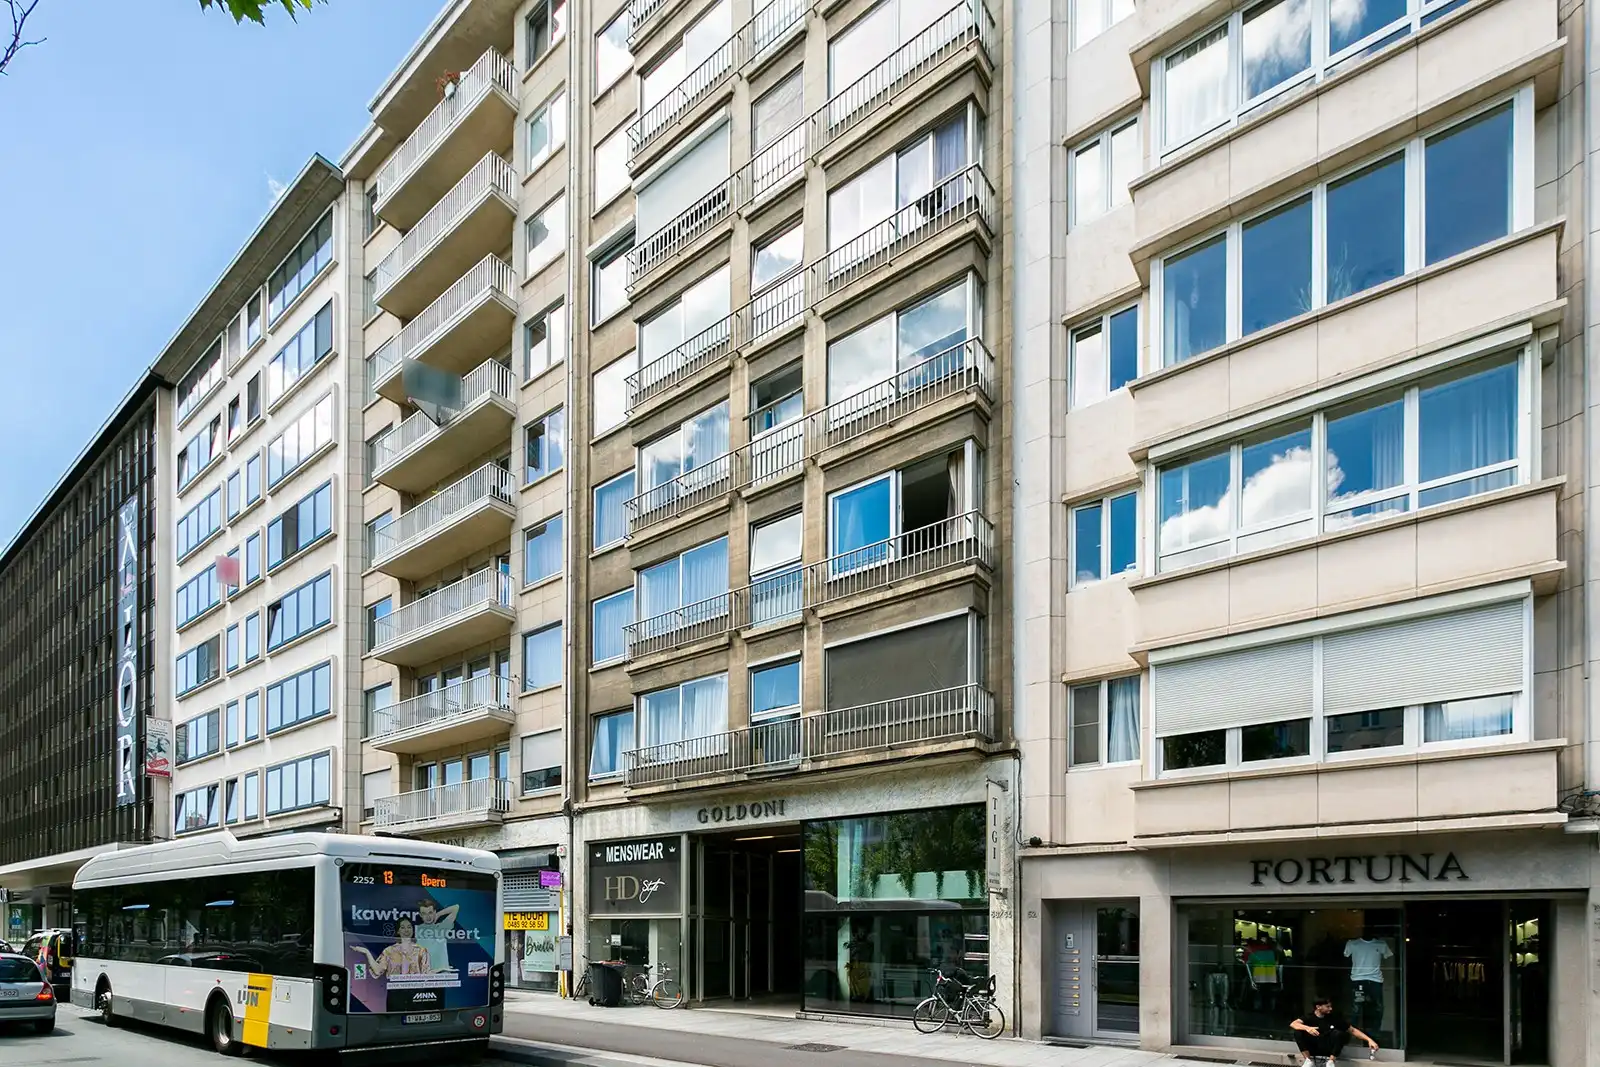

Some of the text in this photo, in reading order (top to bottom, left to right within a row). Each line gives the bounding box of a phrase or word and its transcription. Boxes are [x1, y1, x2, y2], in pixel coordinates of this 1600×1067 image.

[697, 799, 786, 824] GOLDONI
[605, 842, 664, 862] MENSWEAR
[1250, 851, 1470, 885] FORTUNA
[353, 875, 375, 885] 2252
[383, 870, 394, 885] 13
[604, 875, 640, 900] HD
[351, 904, 421, 921] kawtar
[237, 989, 259, 1007] LIJN
[412, 991, 438, 999] MNM
